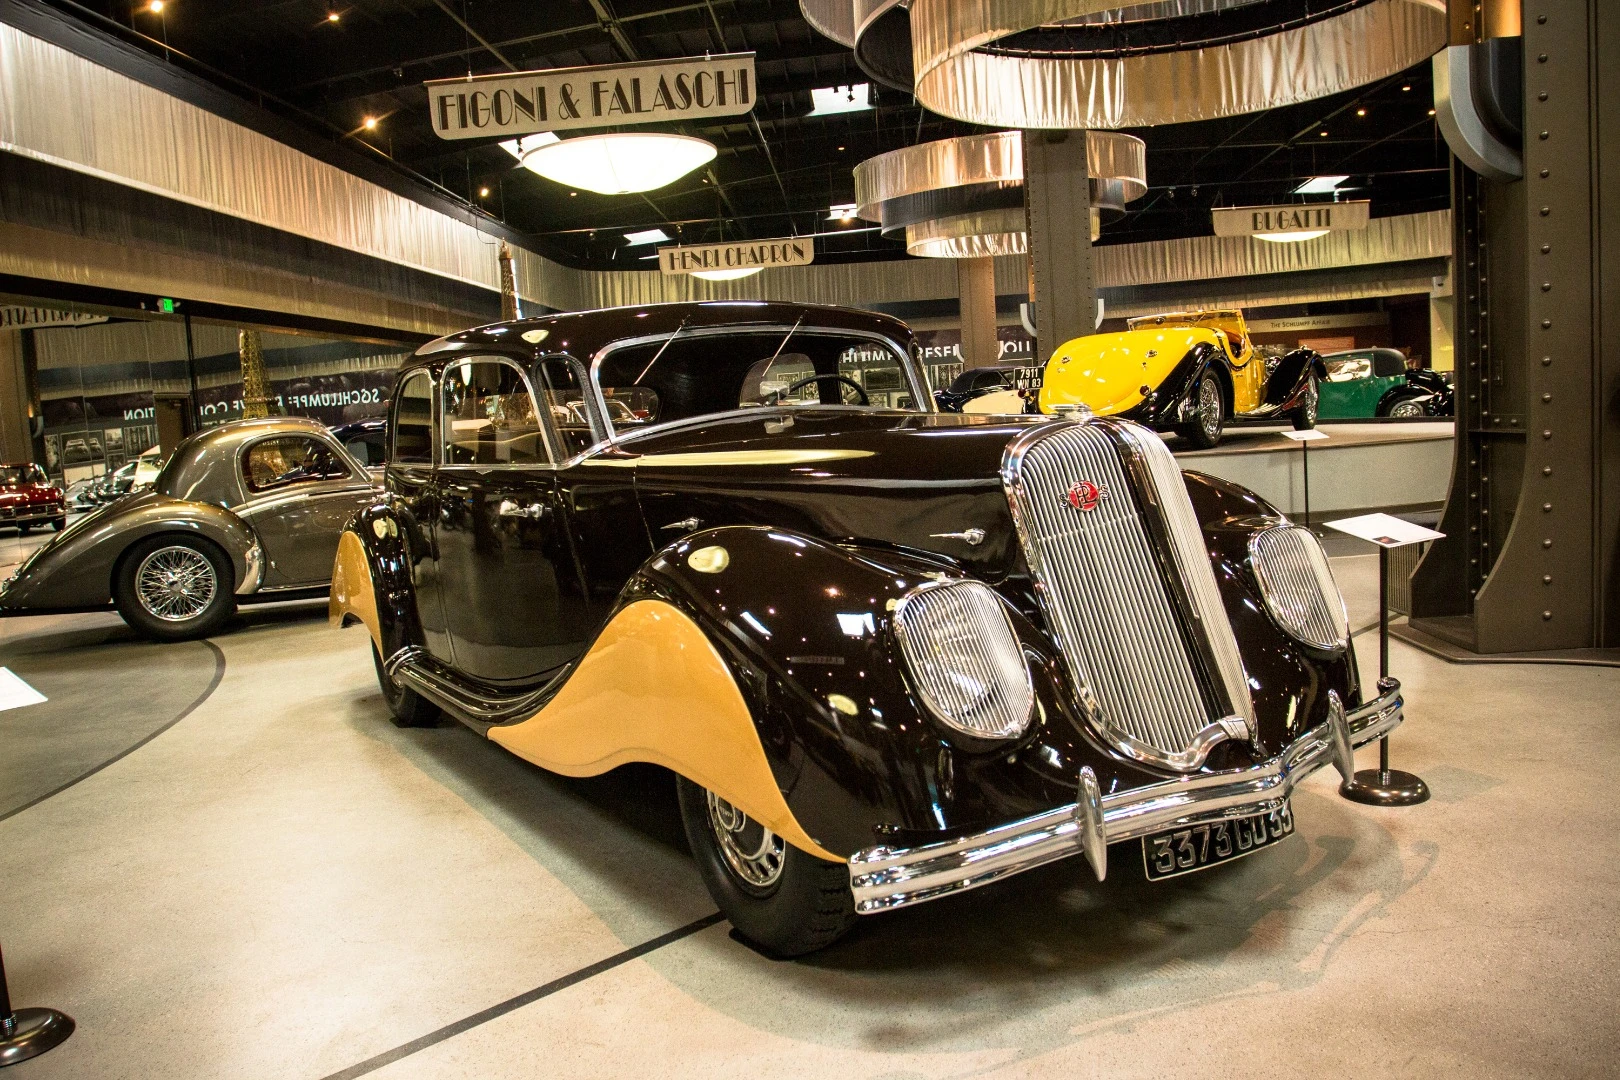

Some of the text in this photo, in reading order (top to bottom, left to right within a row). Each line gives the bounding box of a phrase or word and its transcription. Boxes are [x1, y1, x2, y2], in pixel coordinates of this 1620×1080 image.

[437, 68, 749, 131] FIGONI & FALASCHI
[1252, 208, 1331, 231] BUGATTI
[669, 242, 804, 271] HENRI CHAPRON
[1017, 378, 1042, 389] WN 83
[1020, 368, 1038, 379] 7911
[1153, 820, 1233, 873] 3373
